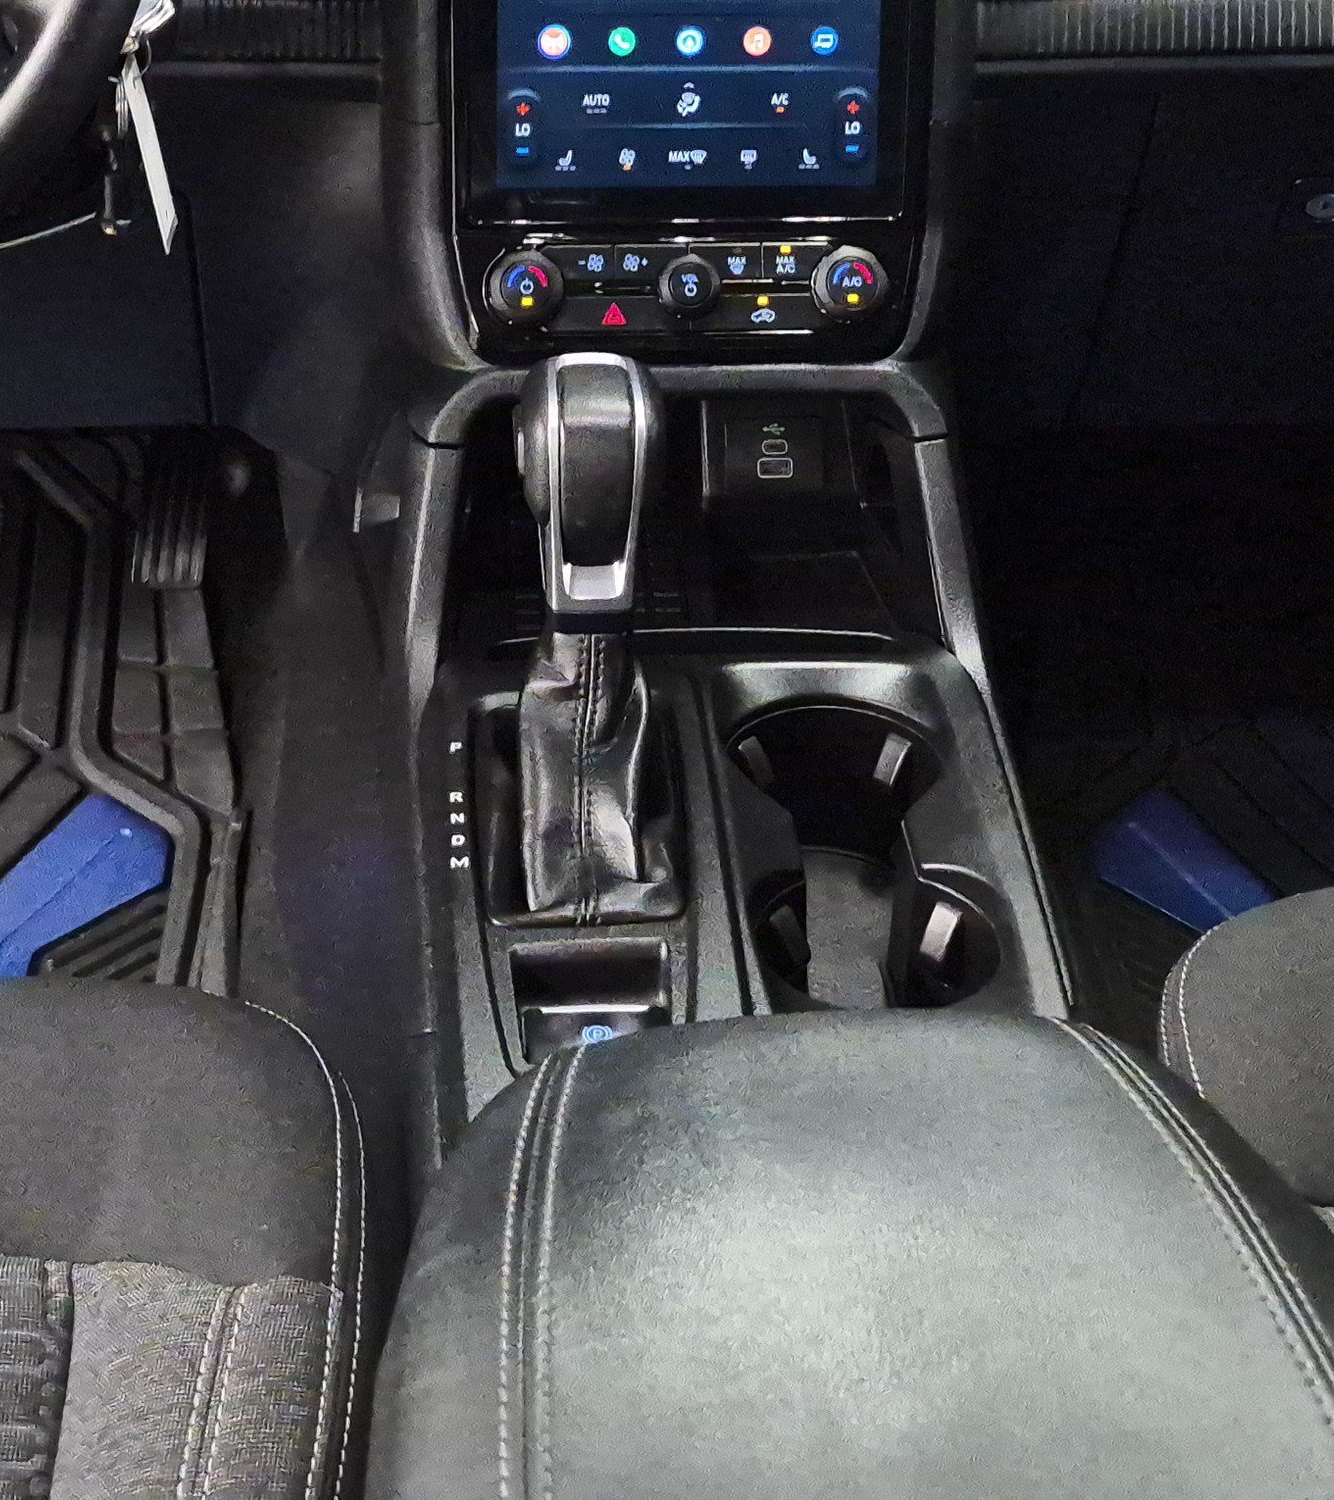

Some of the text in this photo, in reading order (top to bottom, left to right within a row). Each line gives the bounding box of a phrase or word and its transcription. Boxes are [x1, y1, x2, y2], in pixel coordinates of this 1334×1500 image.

[582, 93, 610, 107] AUTO
[771, 92, 789, 106] A/C
[515, 123, 531, 137] LO
[845, 121, 861, 135] LO
[668, 150, 691, 163] MAX
[727, 256, 747, 266] MAX
[775, 256, 795, 266] MAX
[775, 265, 796, 275] A/C
[681, 273, 699, 284] VOL
[450, 742, 463, 753] P
[449, 791, 464, 803] R
[449, 812, 465, 825] N
[450, 833, 466, 847] D
[449, 855, 470, 869] M
